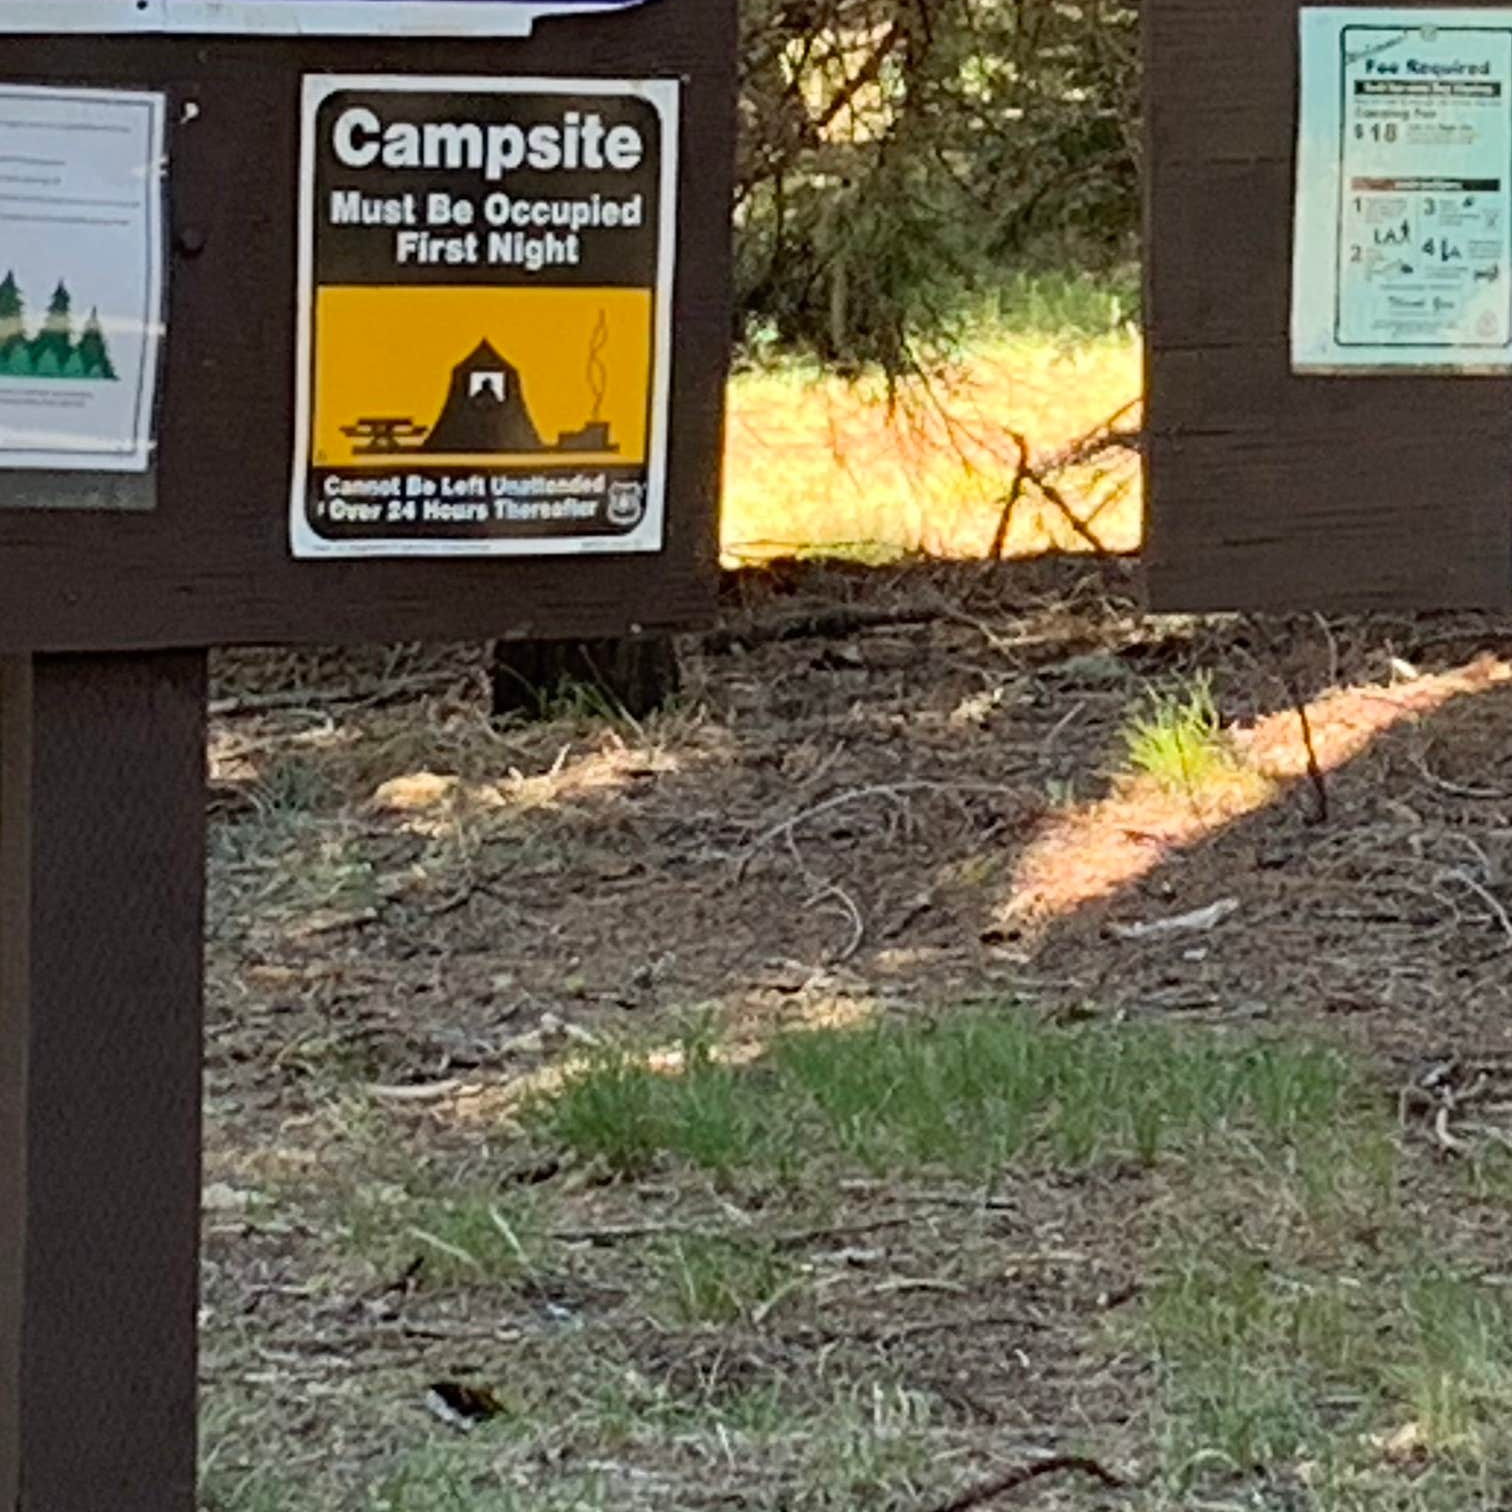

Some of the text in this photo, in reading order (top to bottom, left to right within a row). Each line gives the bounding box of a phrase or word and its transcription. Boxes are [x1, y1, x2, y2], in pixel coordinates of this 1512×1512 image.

[1365, 58, 1491, 78] Fee Required
[332, 109, 643, 179] Campsite
[330, 191, 642, 231] Must Be Occupied
[397, 231, 579, 270] First Night
[324, 474, 605, 496] Cannot Be Left Unattended
[329, 498, 598, 521] Over 24 Hours Thereafter
